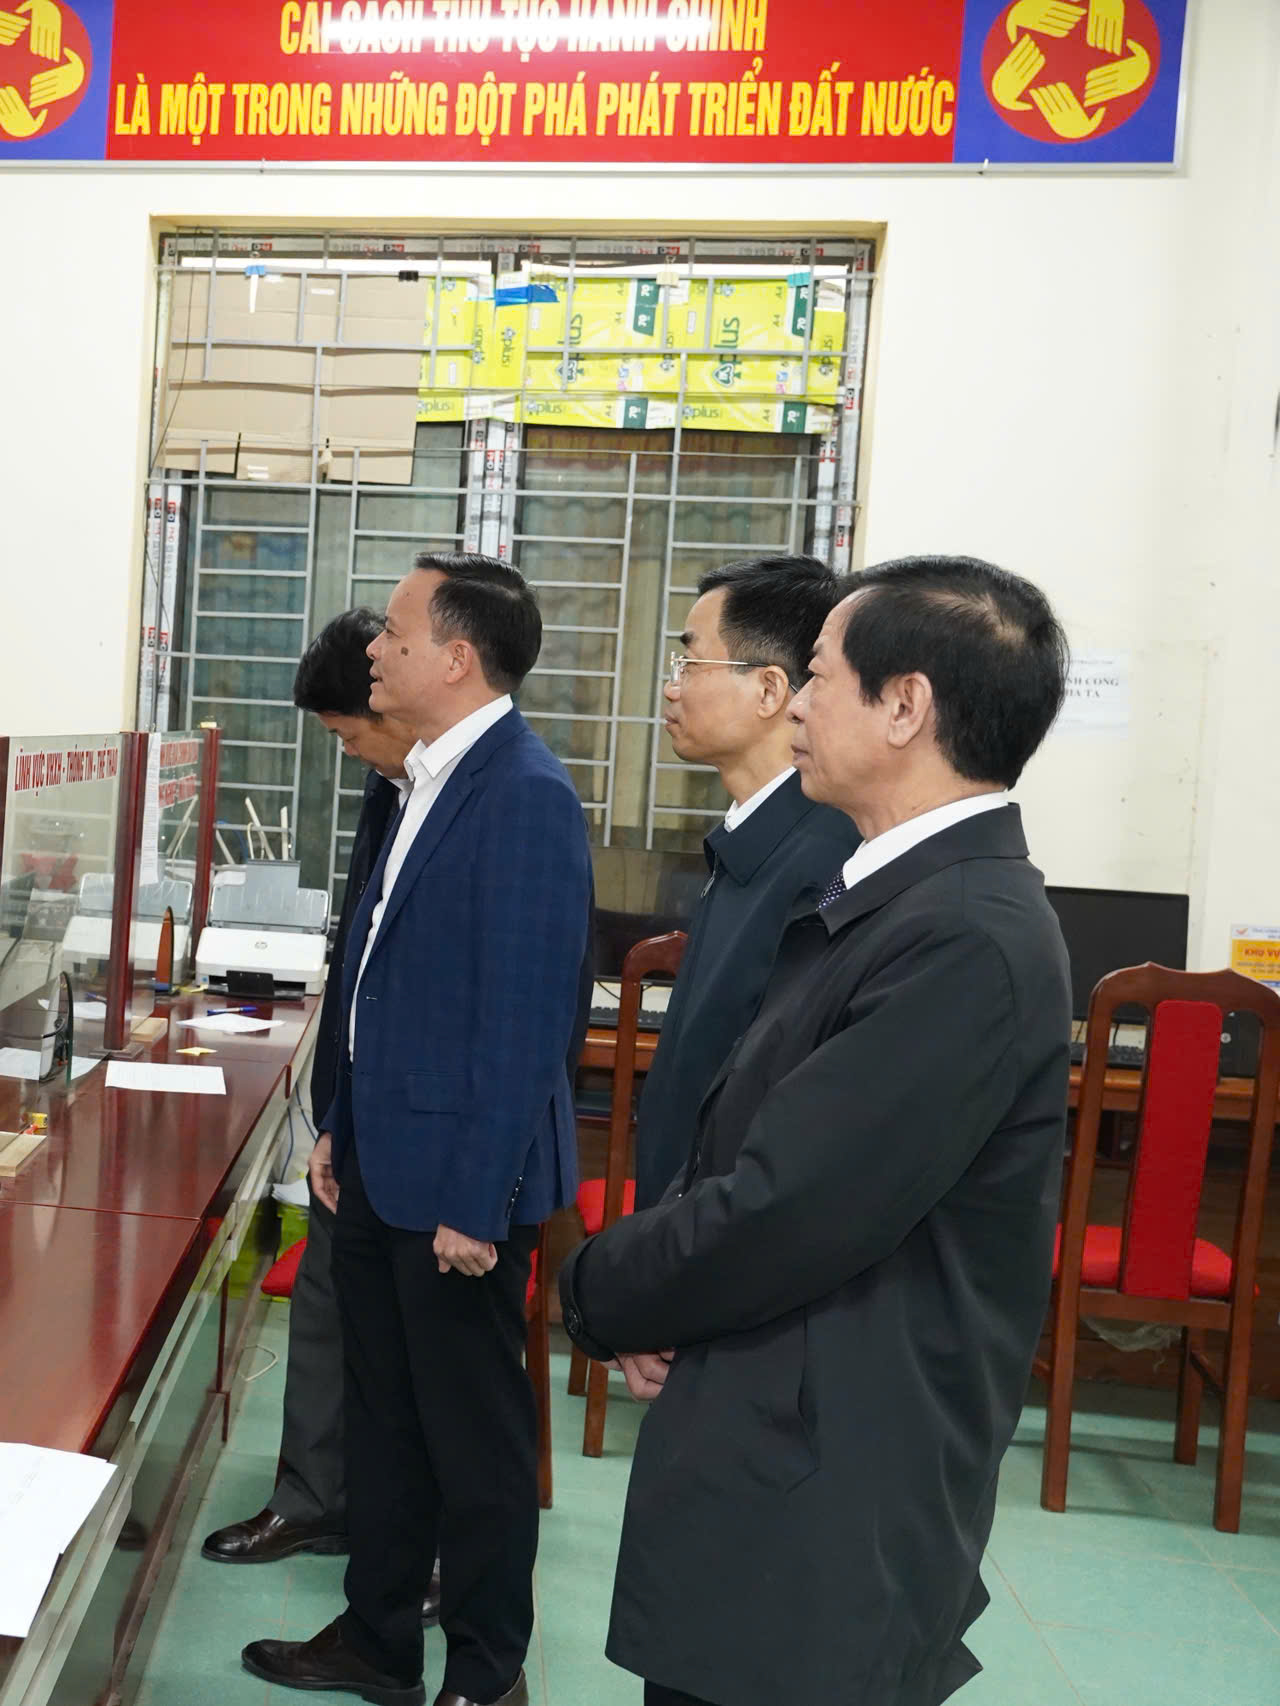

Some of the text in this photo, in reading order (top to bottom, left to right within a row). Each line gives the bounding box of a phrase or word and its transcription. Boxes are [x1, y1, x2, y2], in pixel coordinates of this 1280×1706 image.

[115, 57, 954, 146] LÀ MỘT TRONG NHỮNG ĐỘT PHÁ PHÁT TRIỂN ĐẤT NƯỚC
